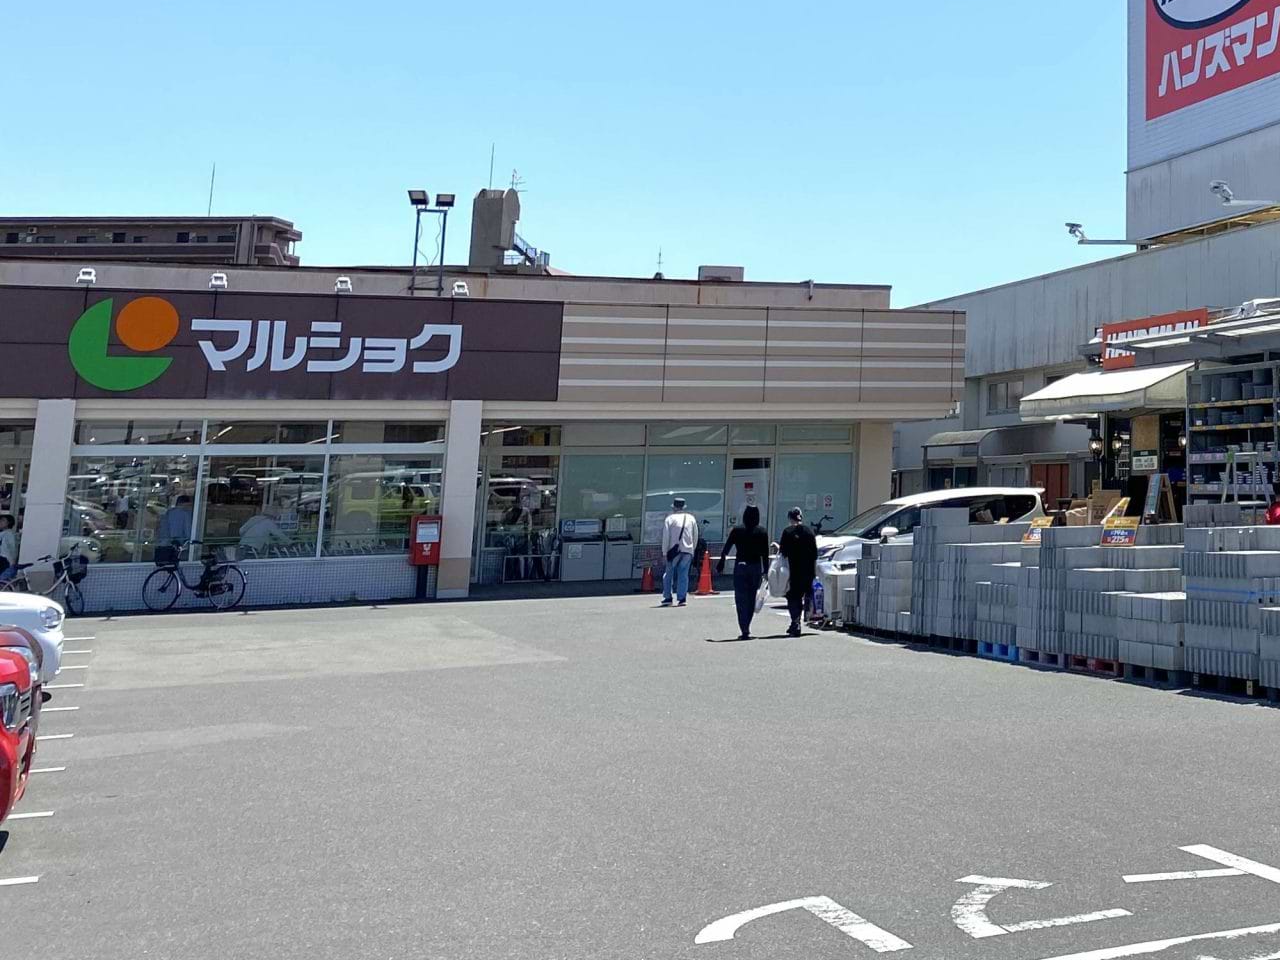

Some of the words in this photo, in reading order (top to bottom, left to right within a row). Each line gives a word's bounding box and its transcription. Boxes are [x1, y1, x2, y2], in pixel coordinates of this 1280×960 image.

[190, 318, 463, 374] マルショク
